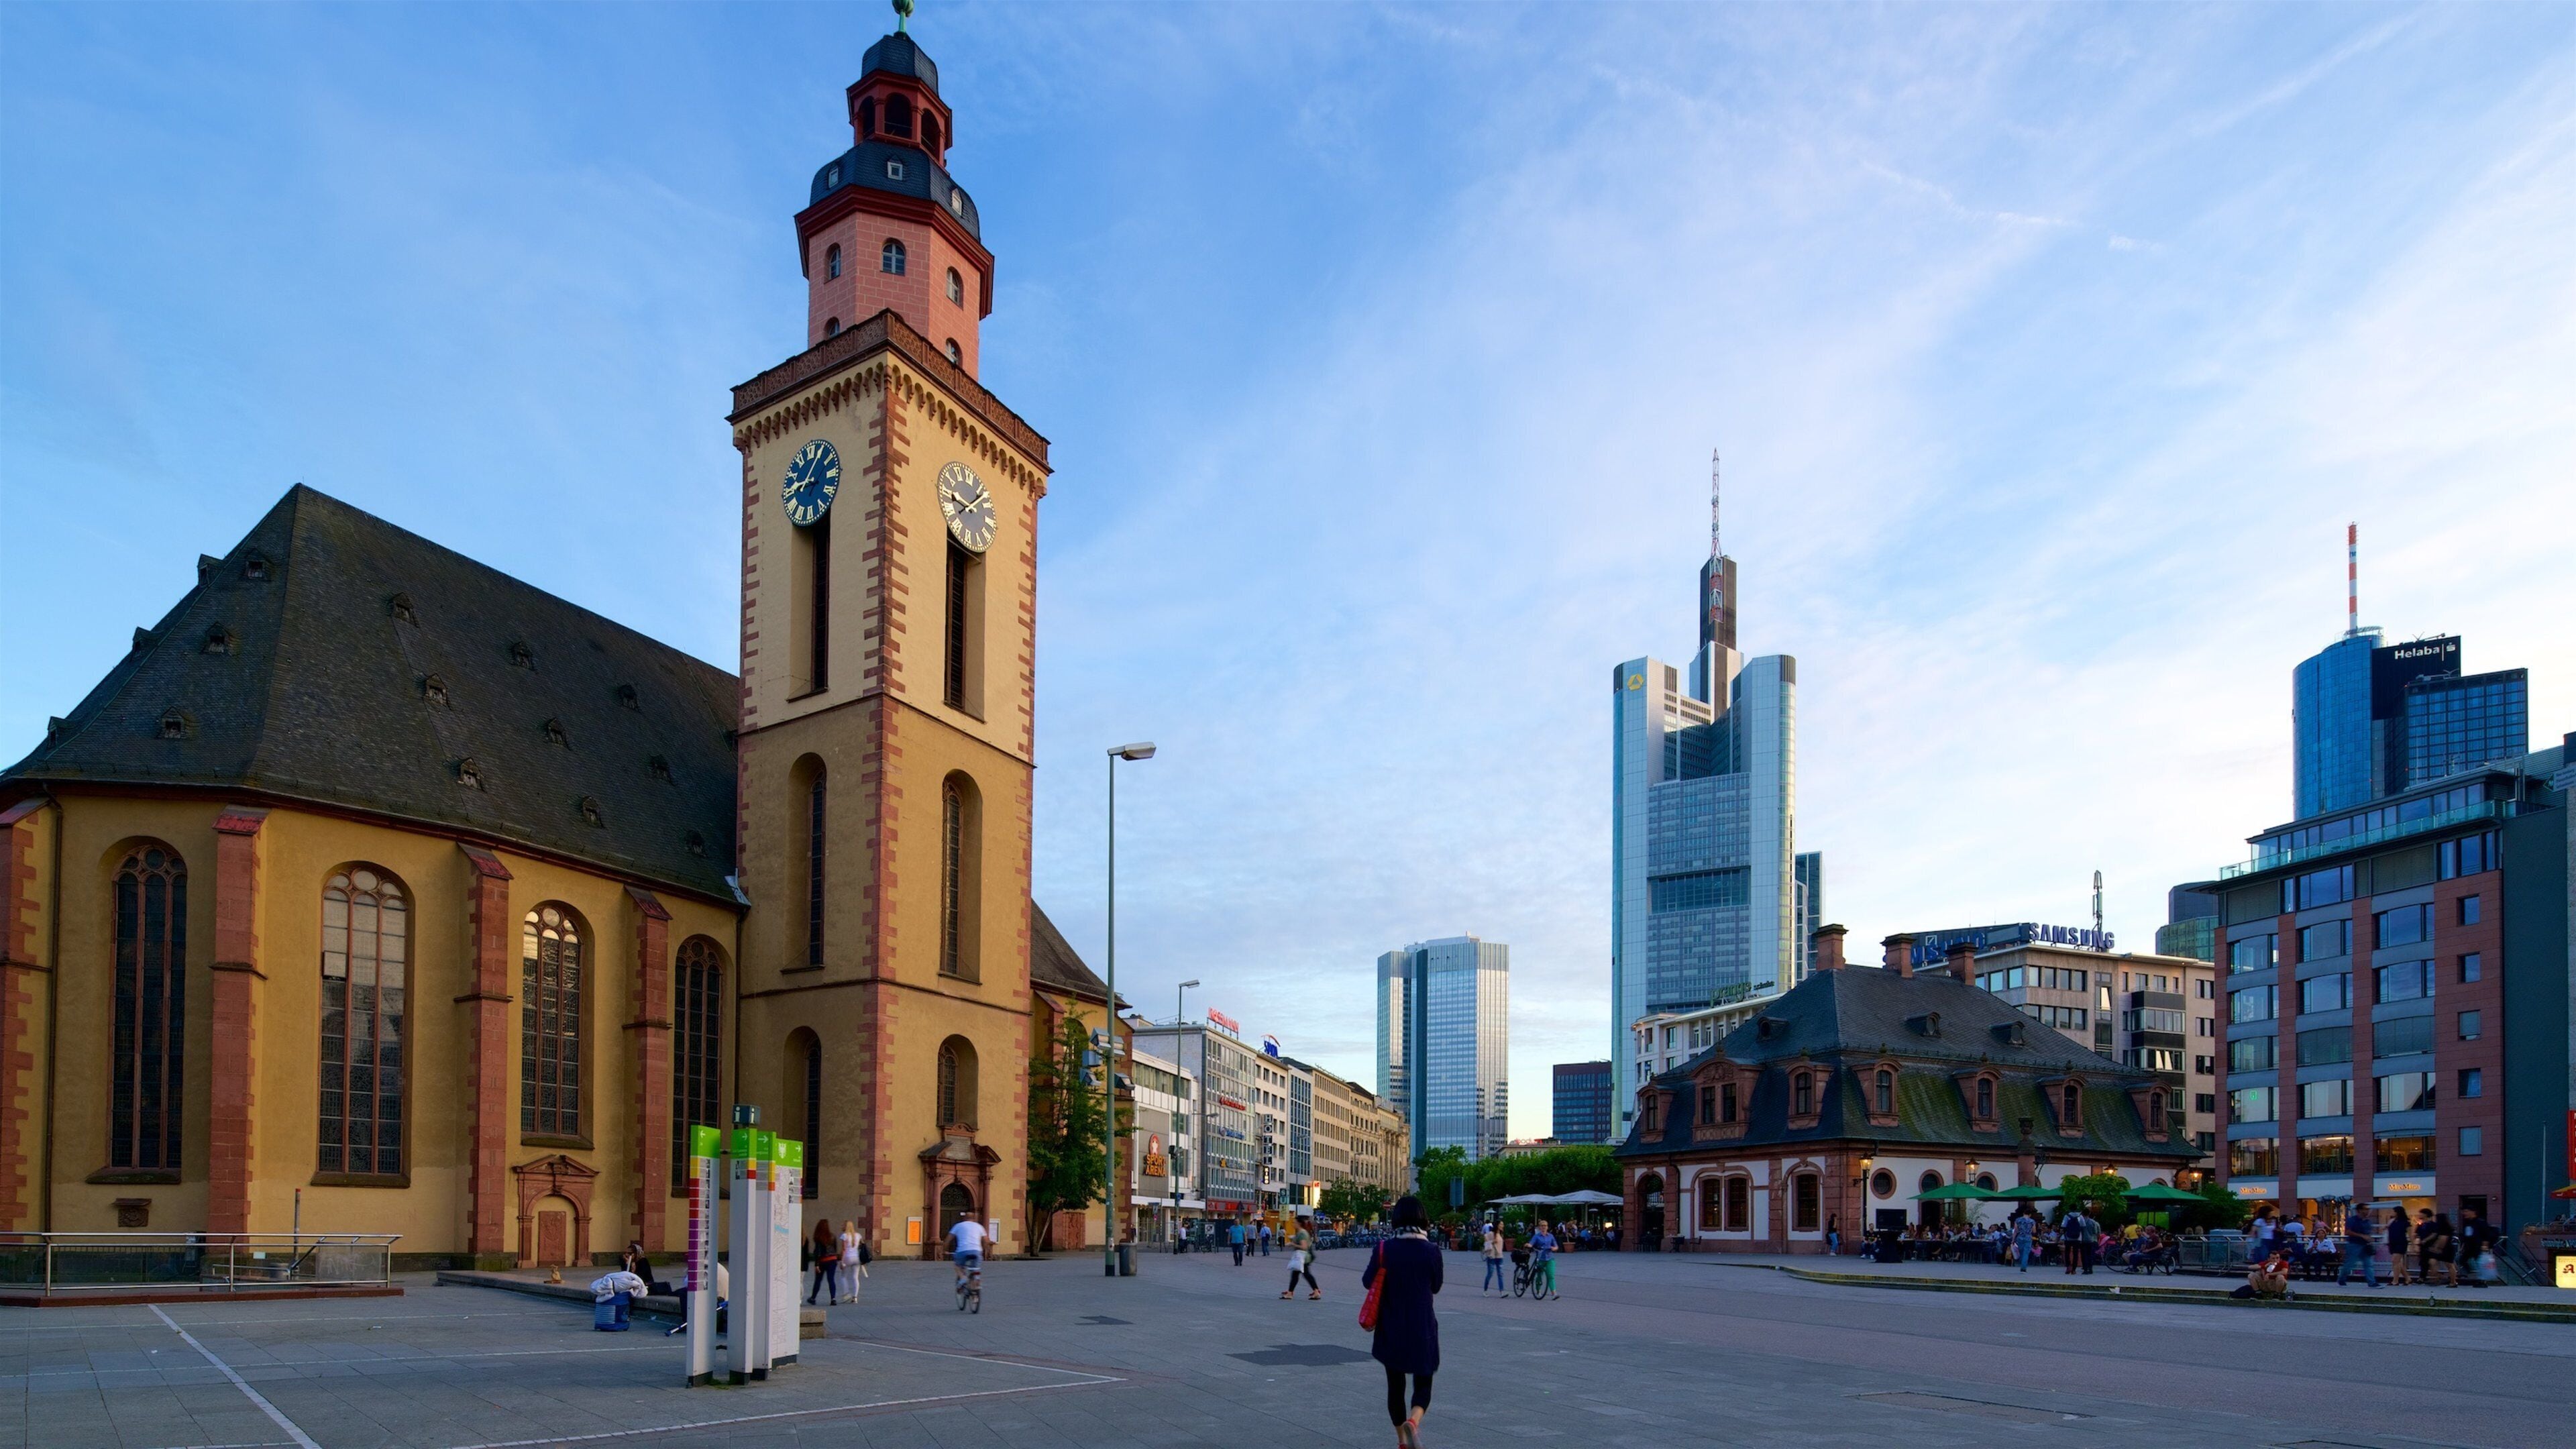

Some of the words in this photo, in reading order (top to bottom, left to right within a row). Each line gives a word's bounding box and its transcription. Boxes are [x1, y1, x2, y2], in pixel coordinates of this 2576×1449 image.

[2394, 646, 2440, 659] Helaba
[2029, 922, 2114, 949] SAMSUNG
[1264, 1114, 1272, 1165] HOTEL
[1144, 1154, 1166, 1166] SPORT
[1143, 1165, 1166, 1177] ARENA
